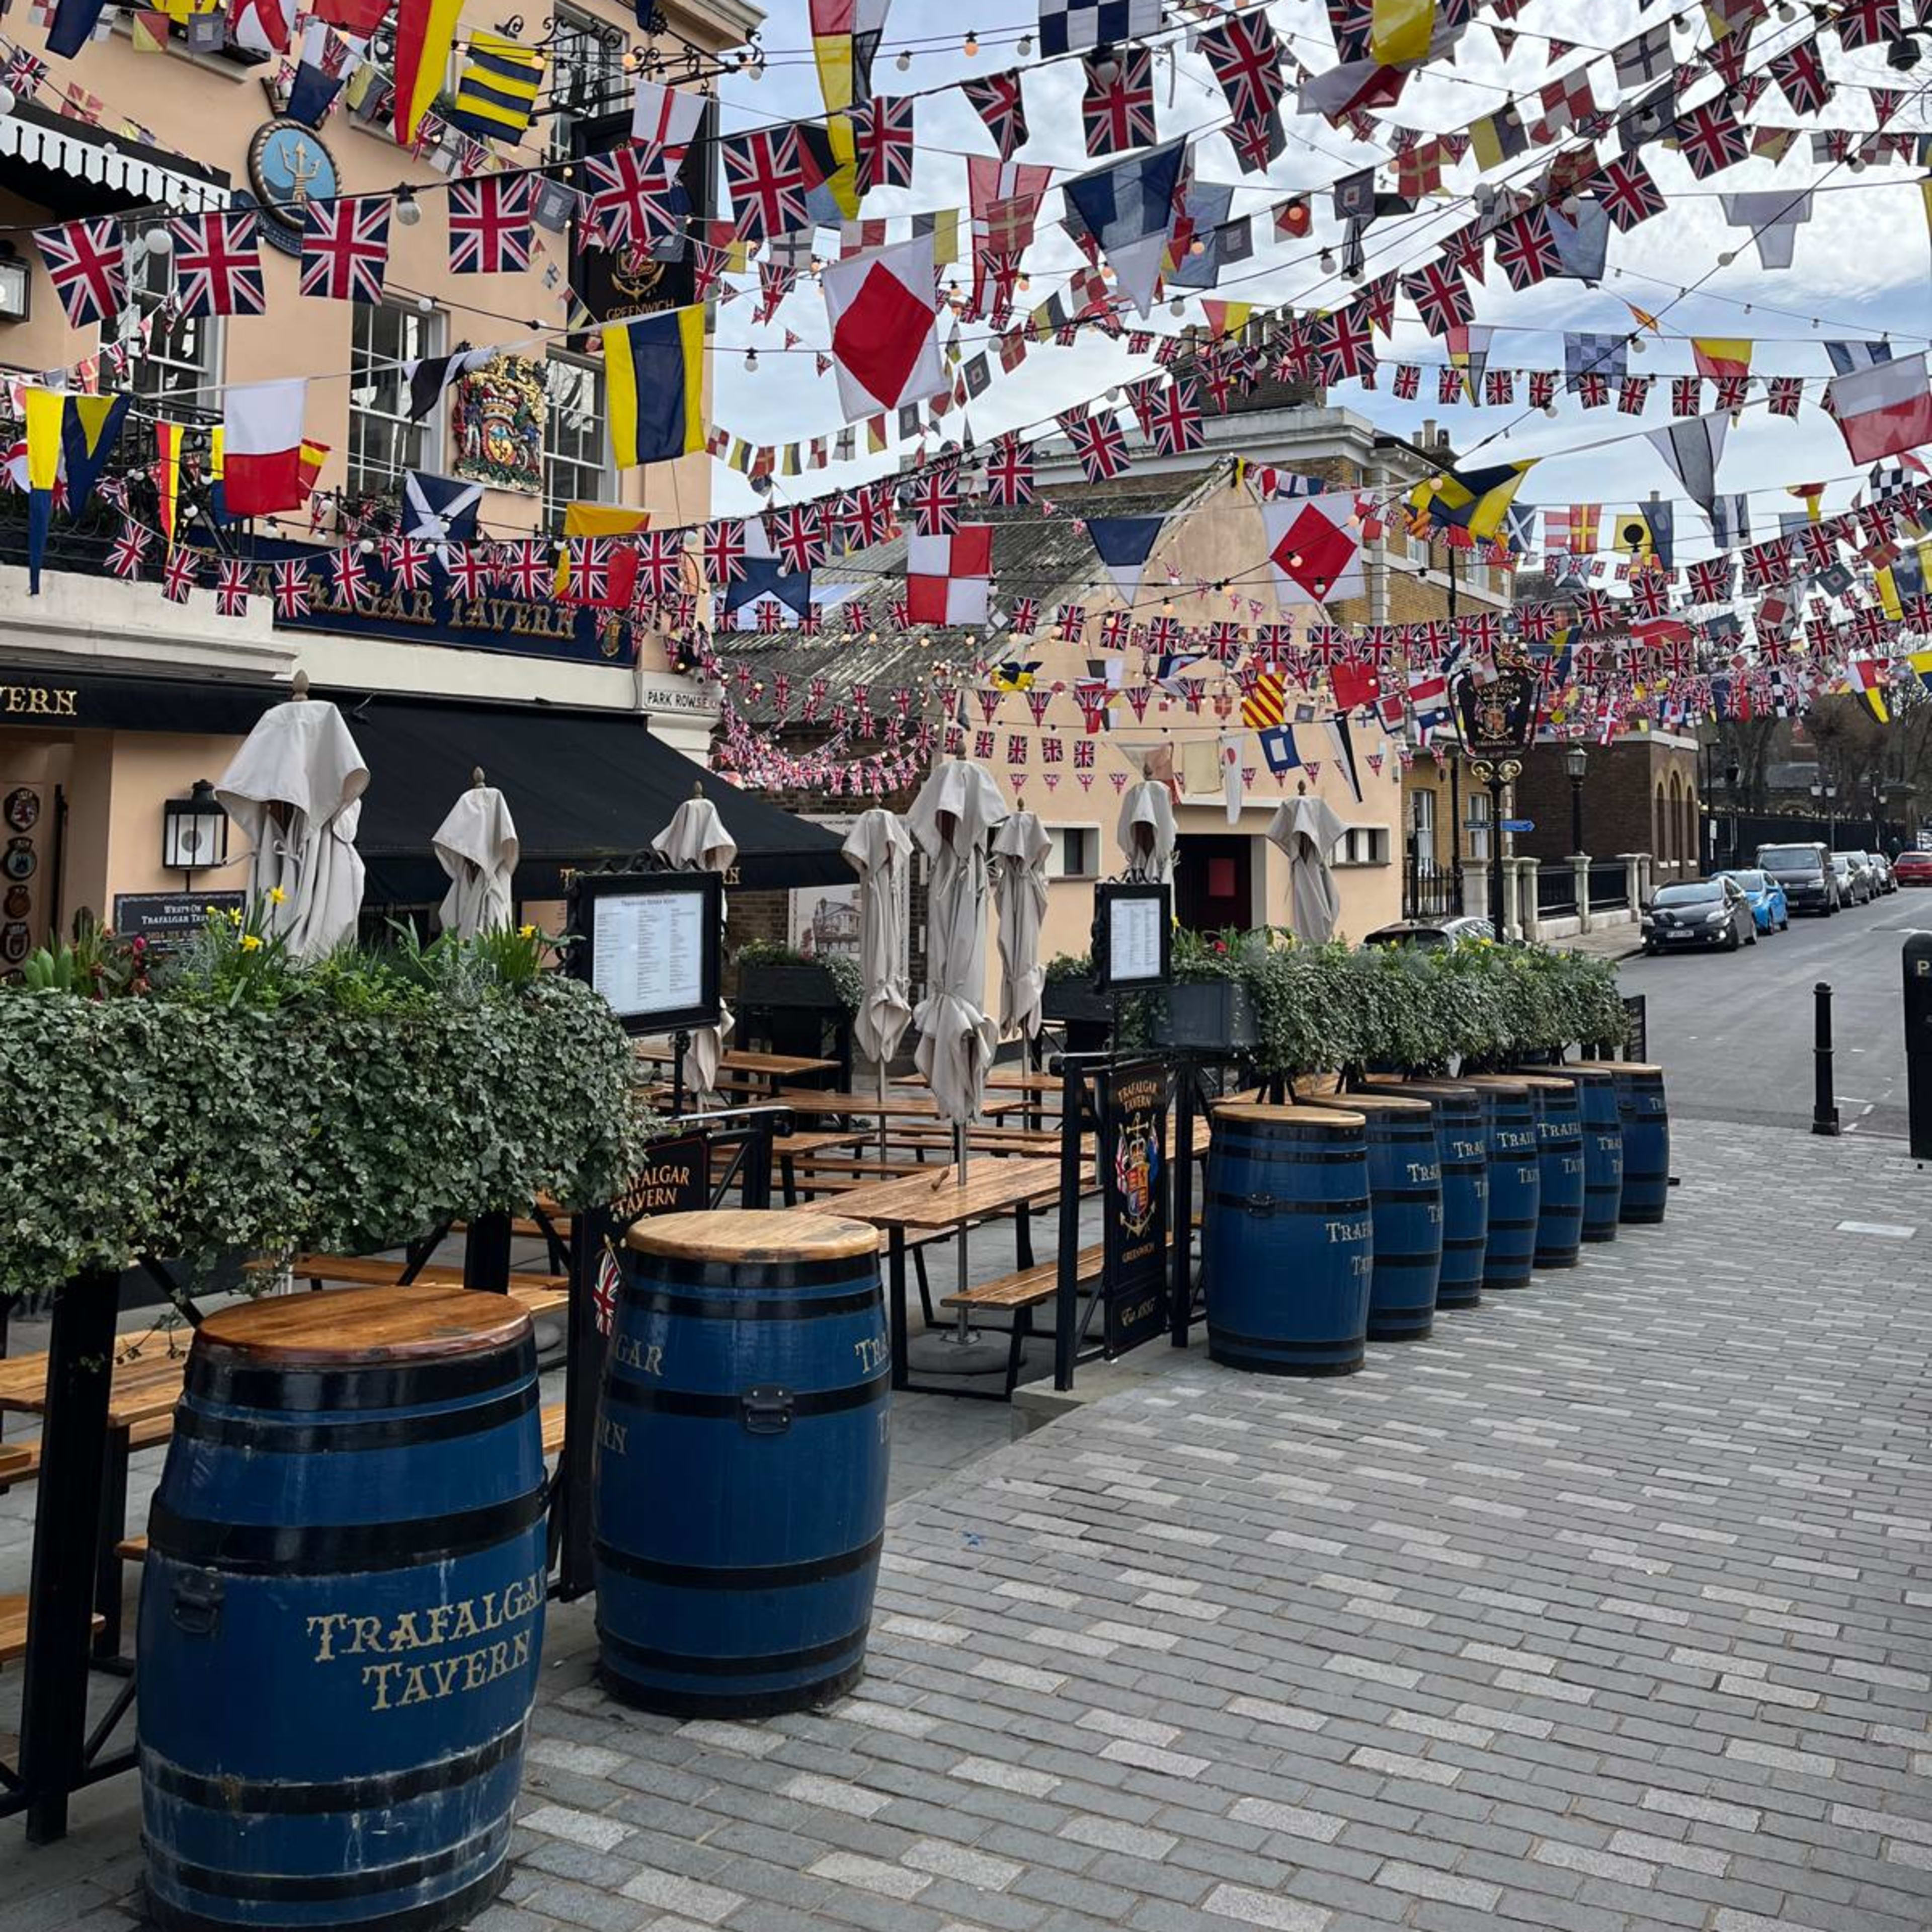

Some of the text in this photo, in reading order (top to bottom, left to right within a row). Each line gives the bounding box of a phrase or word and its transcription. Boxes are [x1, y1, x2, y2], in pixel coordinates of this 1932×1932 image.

[0, 686, 77, 715] ERN
[648, 691, 672, 706] PARK
[676, 693, 696, 708] ROW
[141, 915, 189, 925] TRAFALGAR
[1117, 1080, 1157, 1102] TRAFALGAR
[1124, 1095, 1152, 1113] TAVERN
[626, 1165, 691, 1191] AFALGAR
[615, 1187, 678, 1216] TAVERN
[362, 1630, 531, 1711] TAVERN
